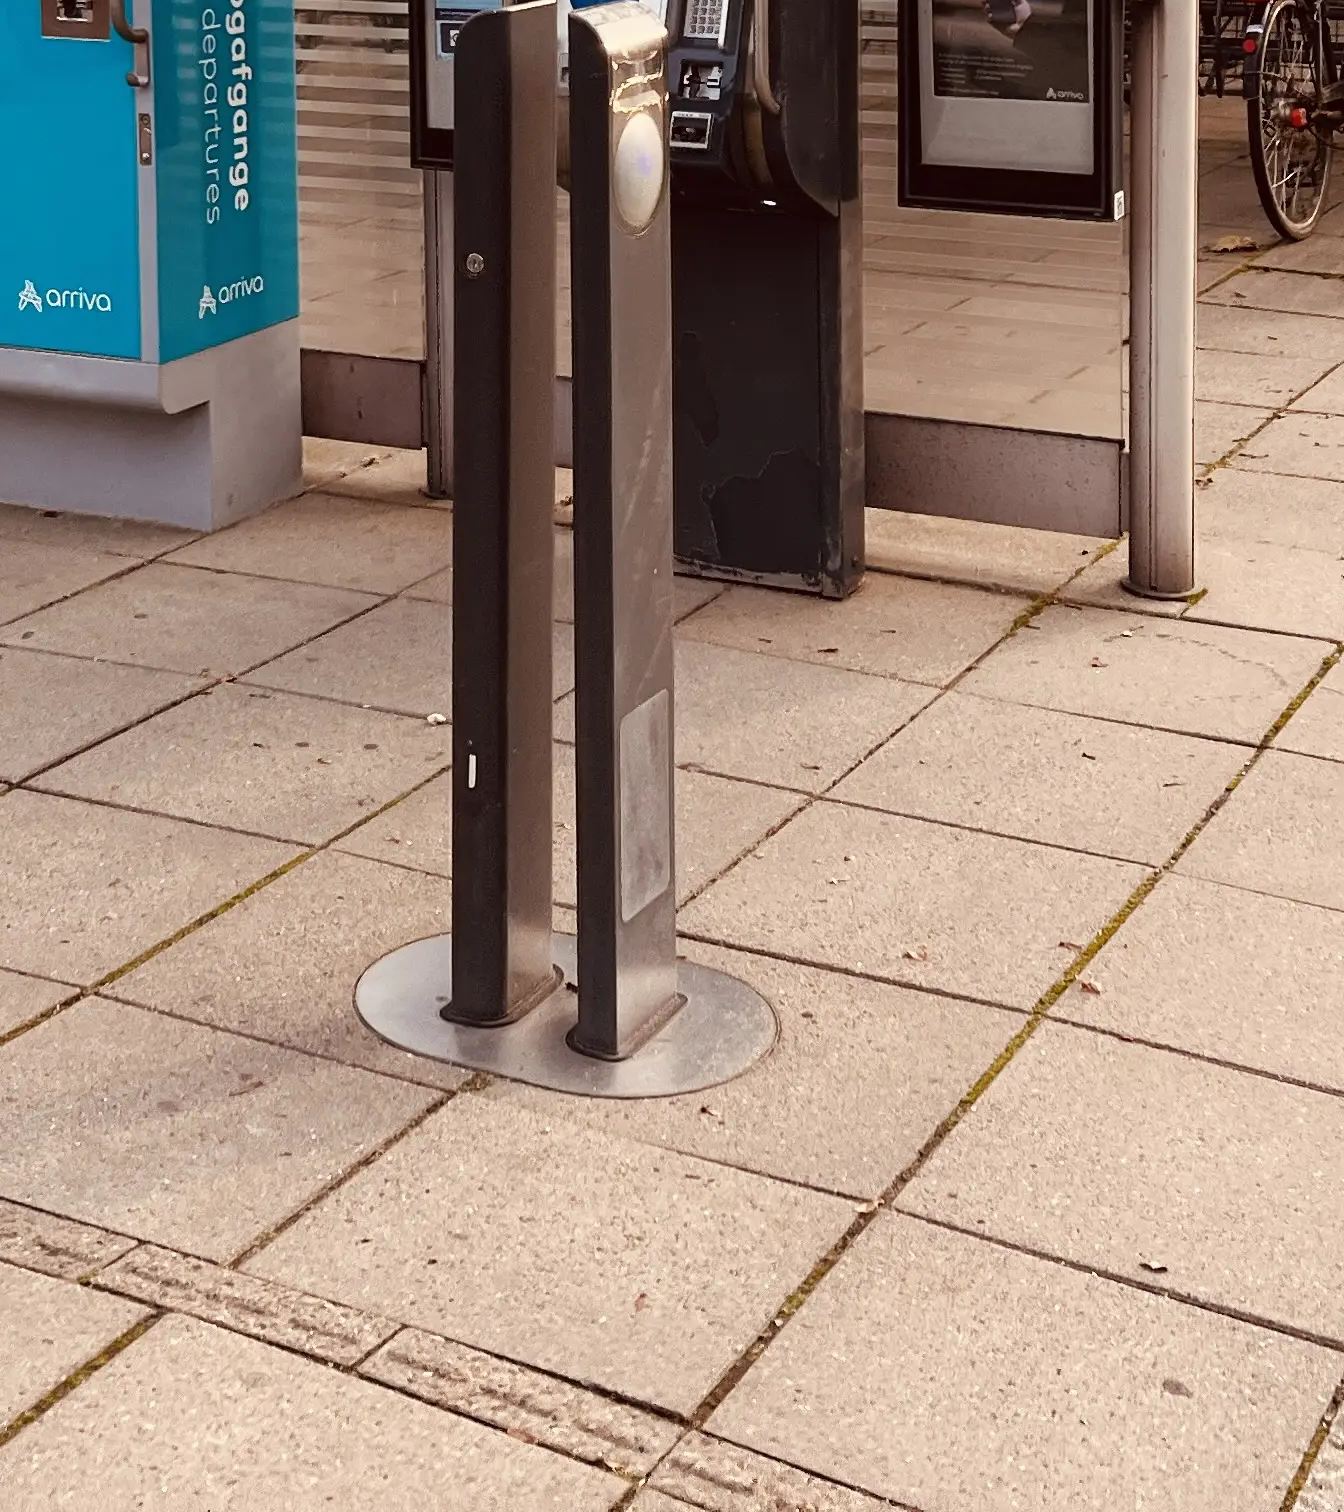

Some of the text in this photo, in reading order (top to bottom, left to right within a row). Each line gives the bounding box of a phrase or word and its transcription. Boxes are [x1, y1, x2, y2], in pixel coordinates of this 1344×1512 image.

[198, 8, 223, 225] departures
[45, 287, 112, 312] arriva
[218, 274, 264, 304] arriva
